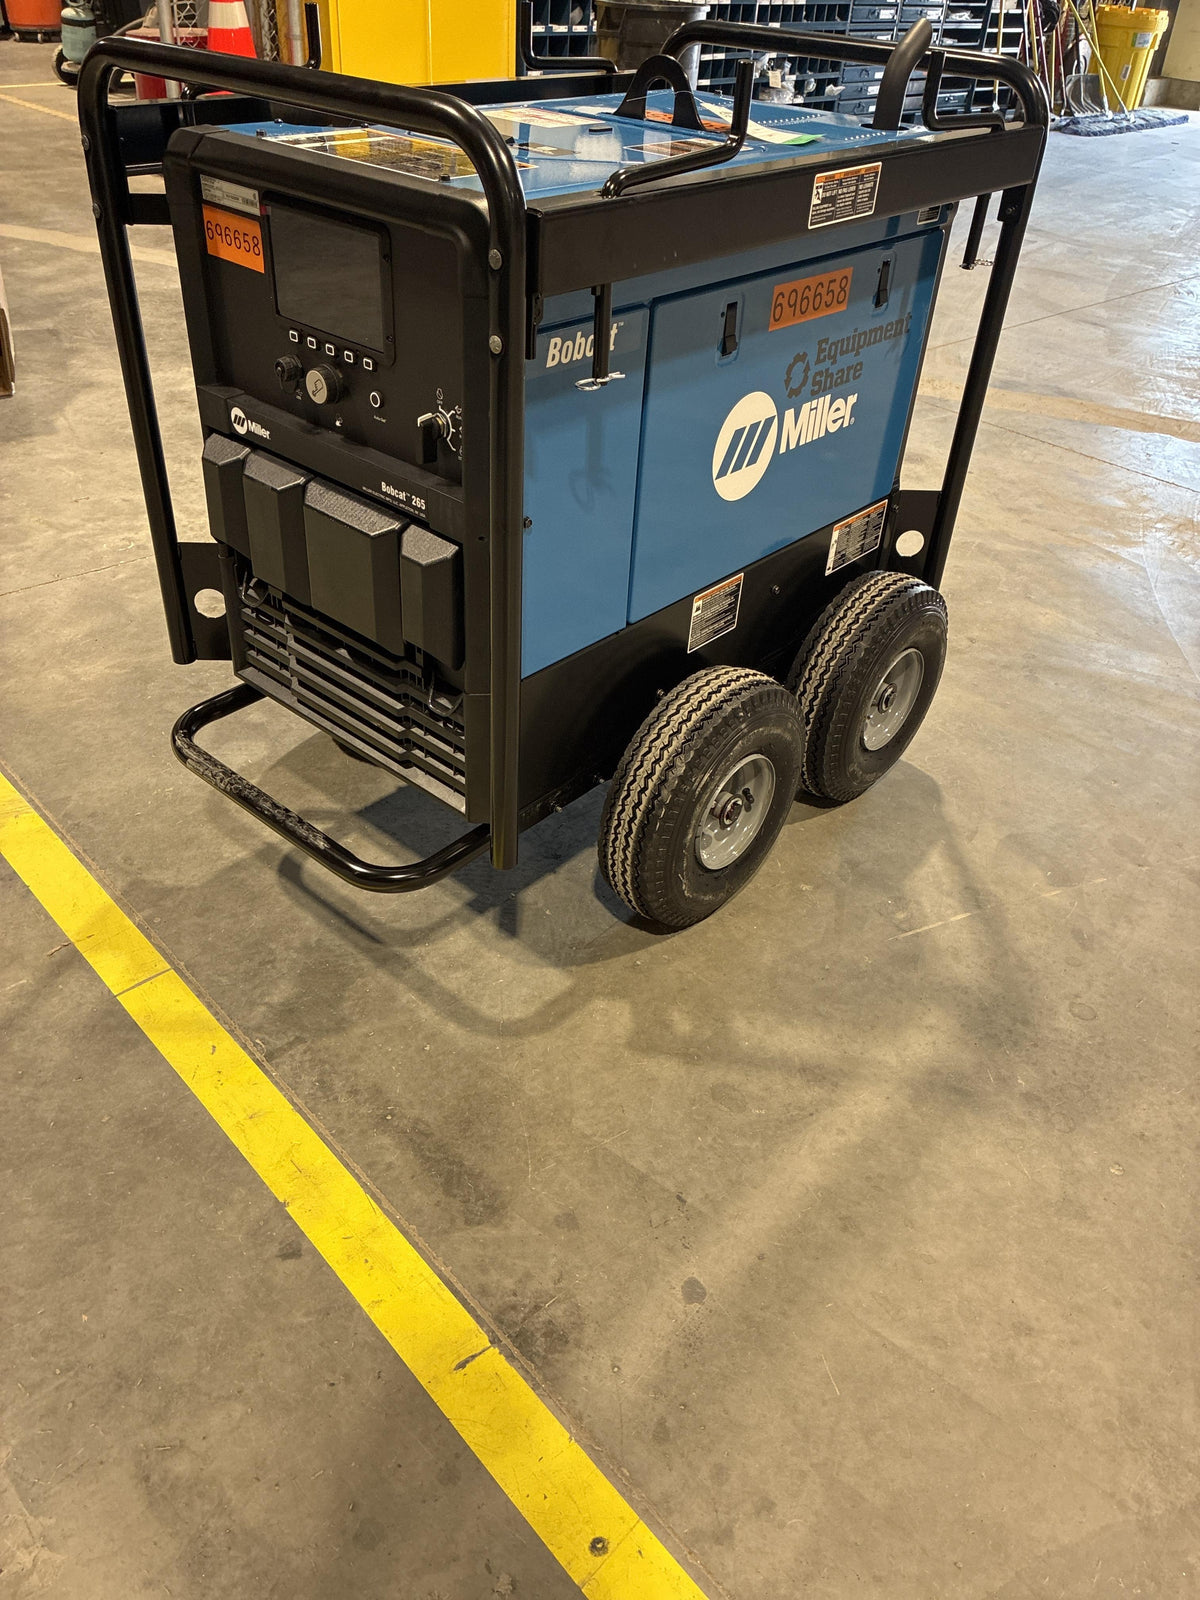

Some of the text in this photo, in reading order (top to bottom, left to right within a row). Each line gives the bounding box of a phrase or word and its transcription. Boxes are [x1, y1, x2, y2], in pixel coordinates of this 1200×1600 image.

[205, 220, 261, 256] 696658
[773, 275, 849, 323] 696658
[546, 323, 618, 368] Bobct
[814, 312, 912, 365] Equipment
[810, 361, 864, 397] Share
[381, 481, 407, 501] Bobcat
[411, 495, 426, 510] 265
